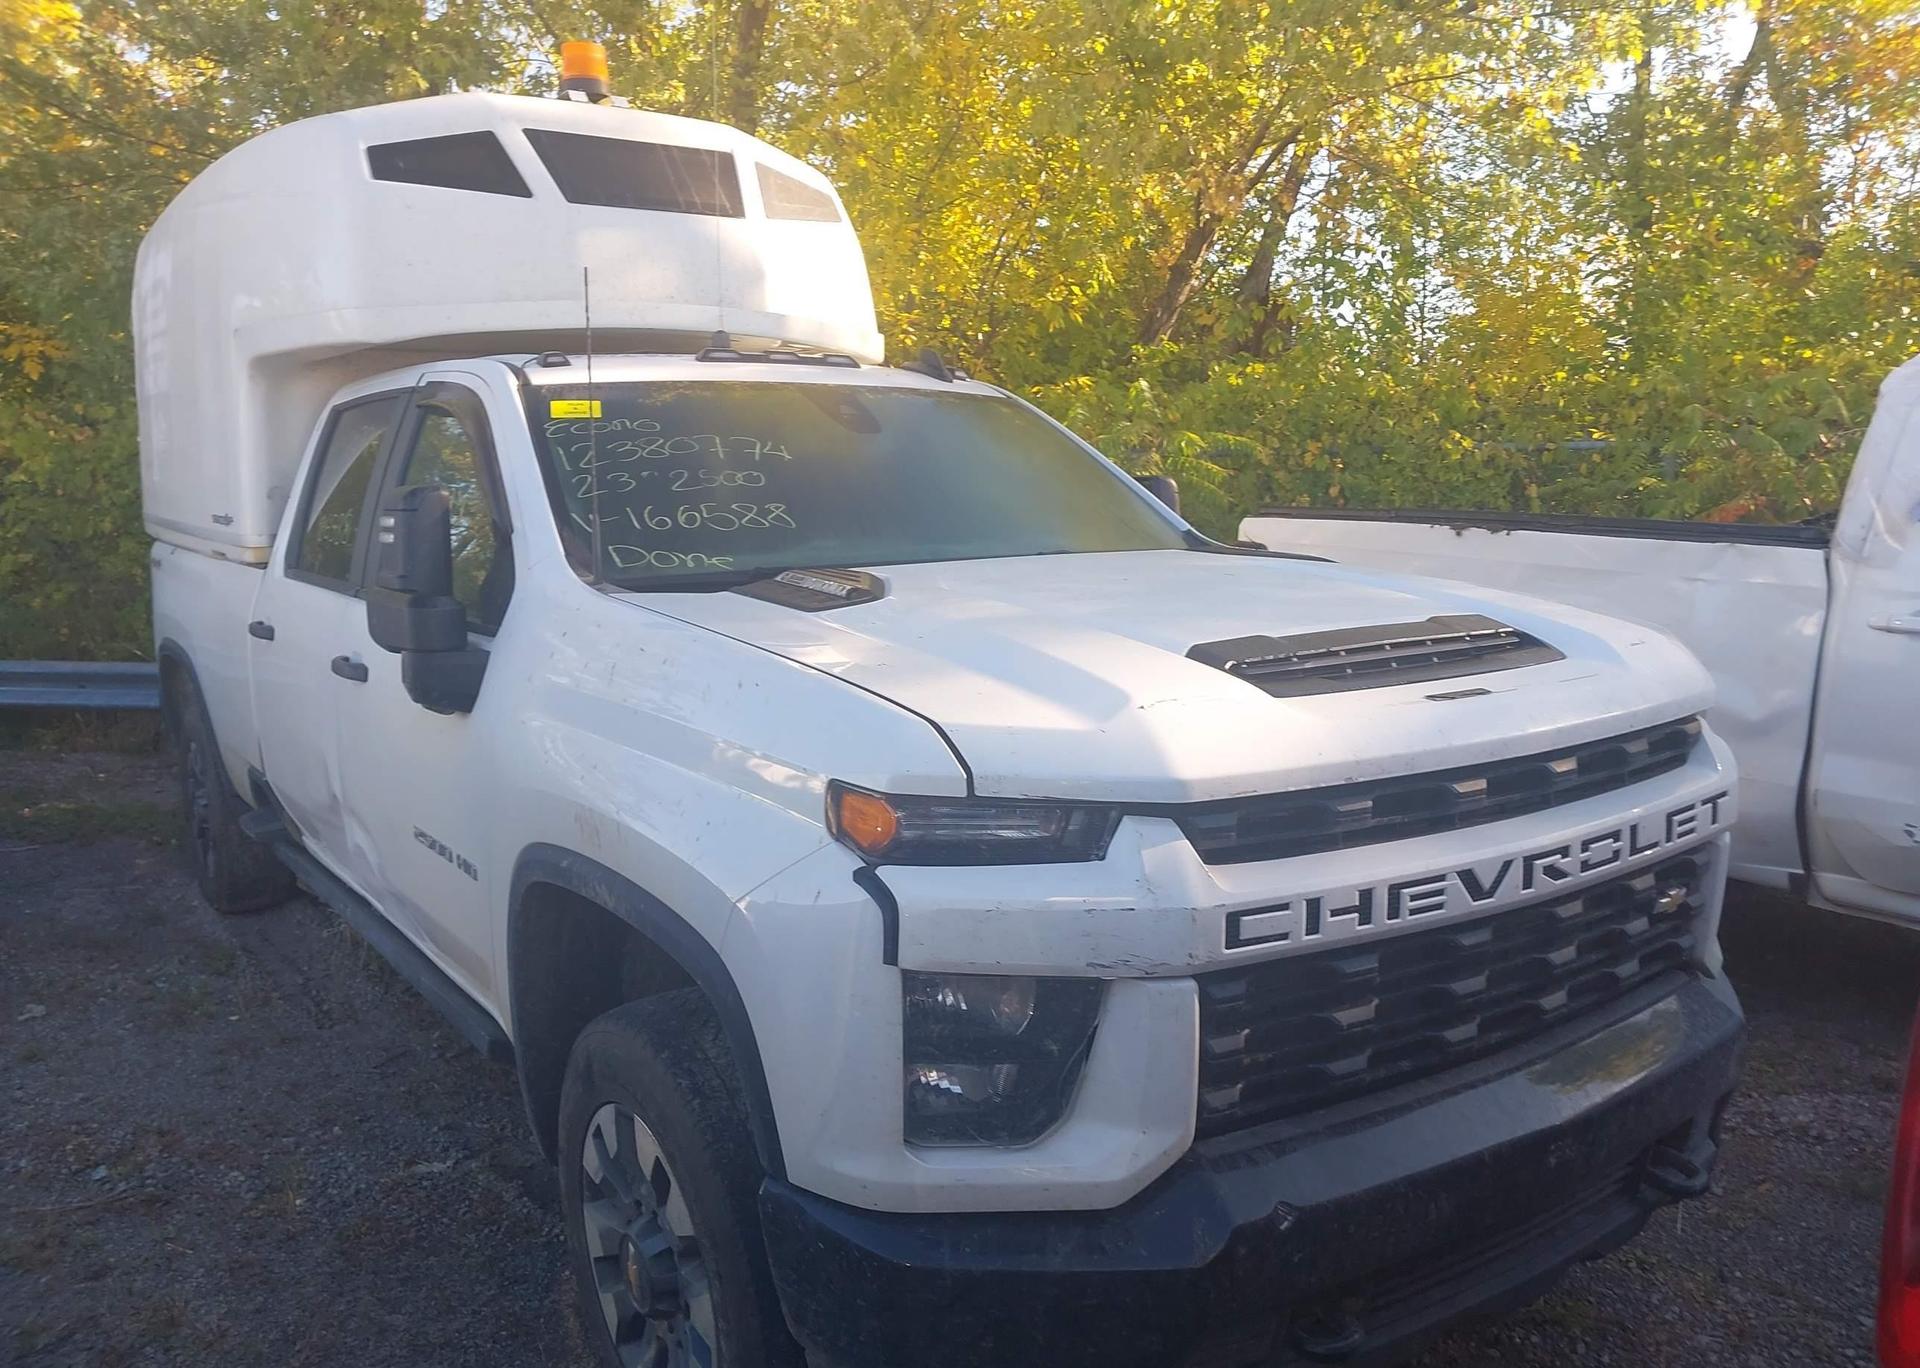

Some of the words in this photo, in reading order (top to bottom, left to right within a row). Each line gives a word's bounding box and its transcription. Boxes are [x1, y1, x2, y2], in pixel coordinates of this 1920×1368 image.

[557, 434, 792, 470] 12380774
[668, 469, 766, 491] 2500
[608, 544, 733, 570] Done
[1223, 790, 1729, 951] CHEVROLET
